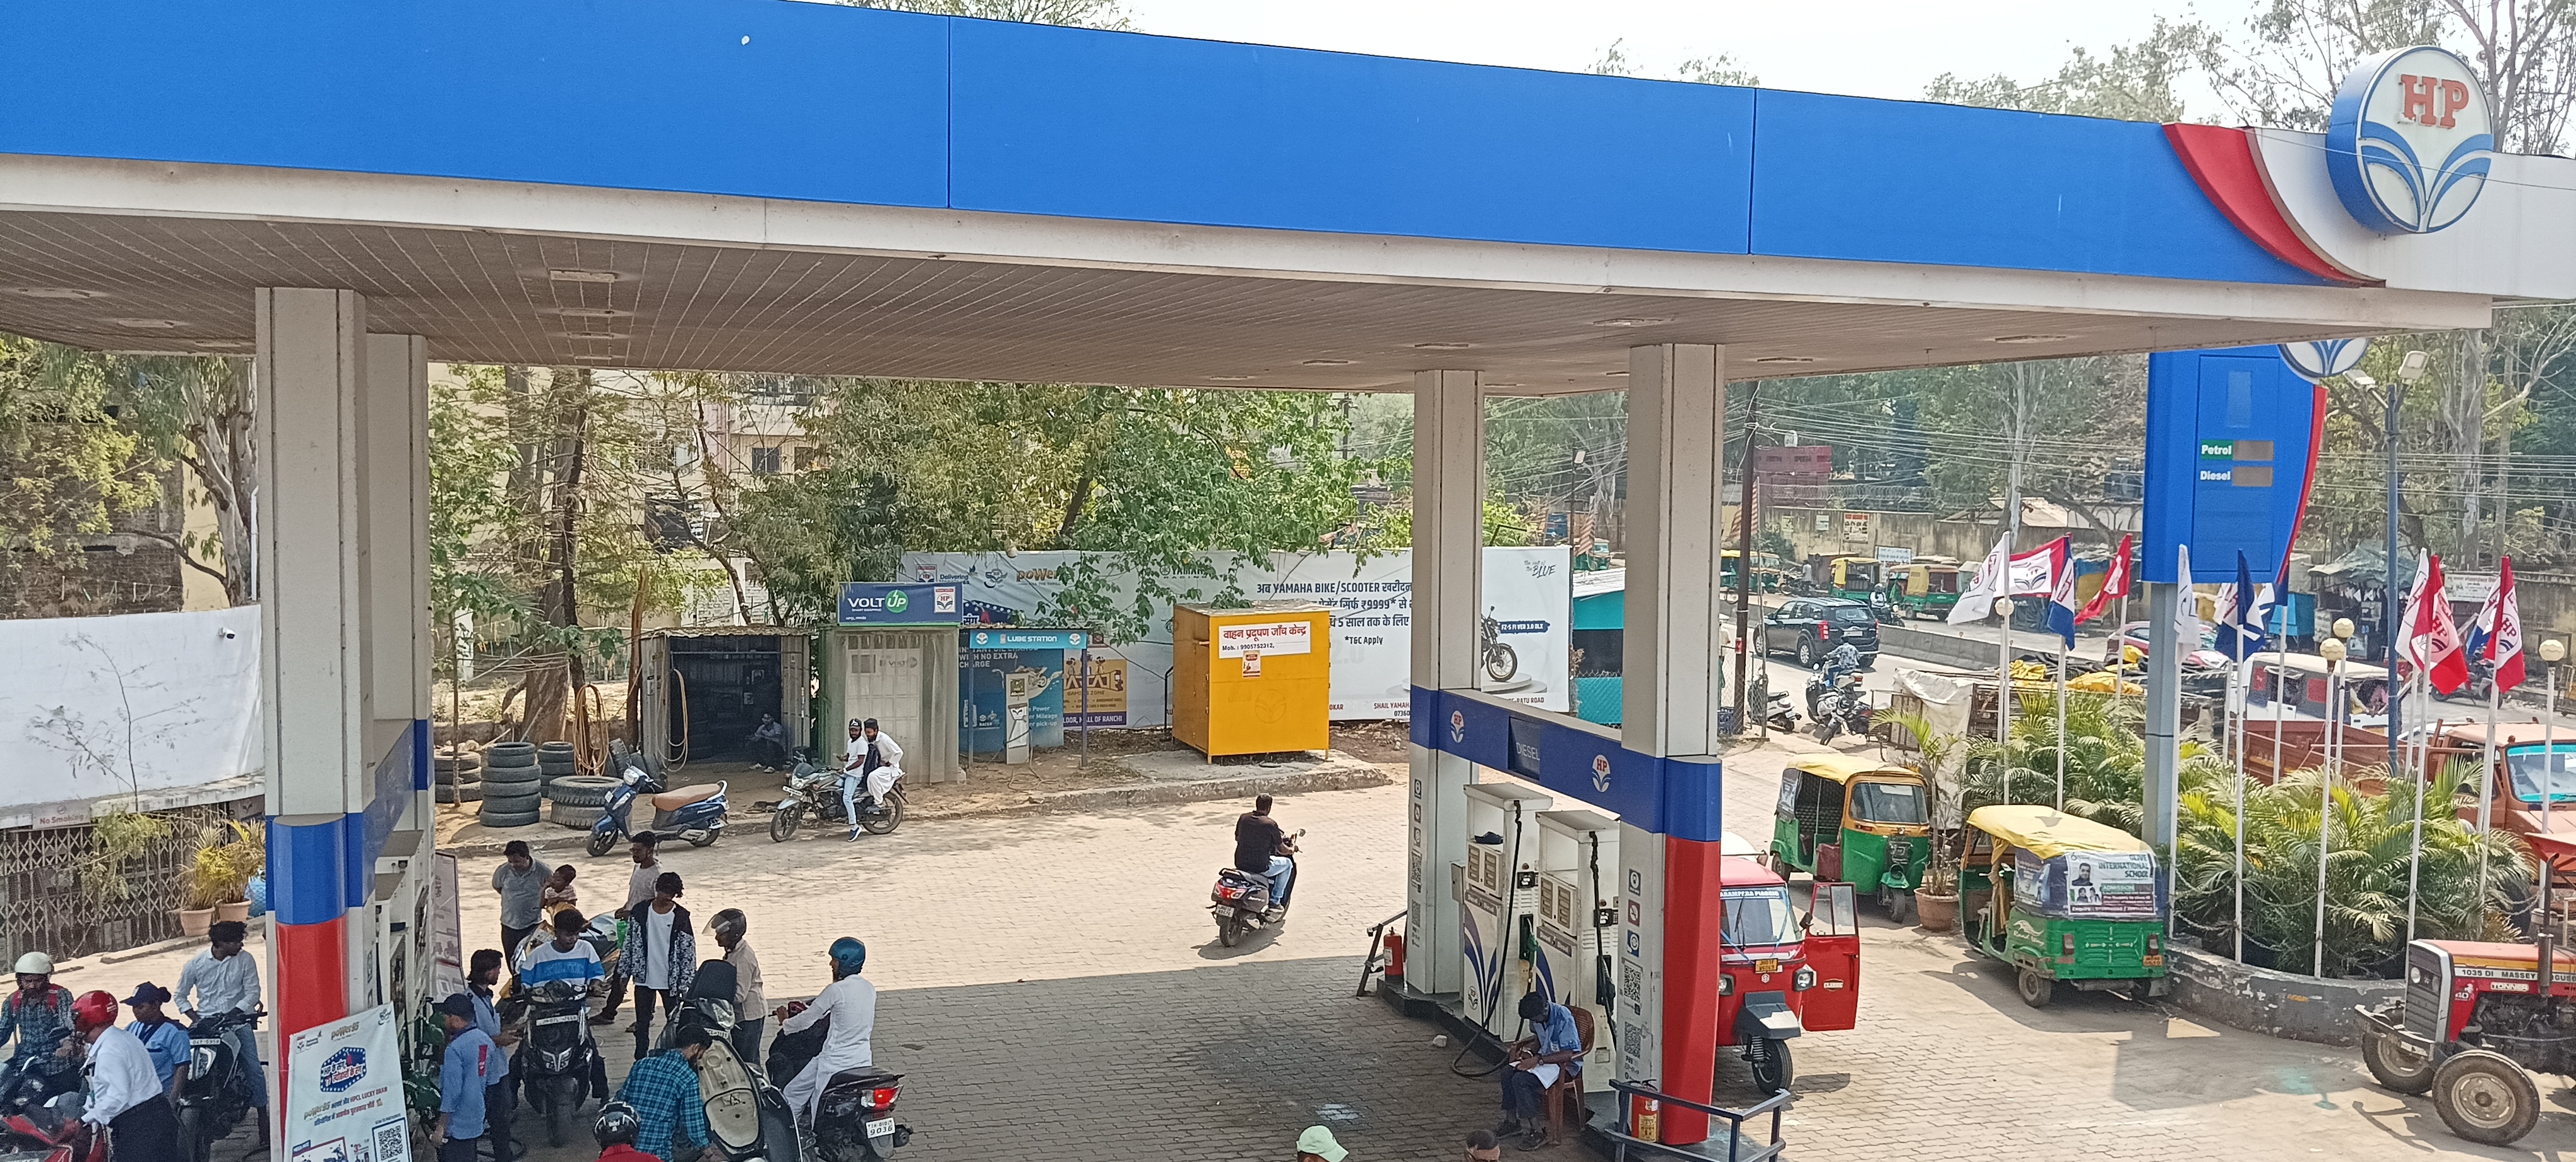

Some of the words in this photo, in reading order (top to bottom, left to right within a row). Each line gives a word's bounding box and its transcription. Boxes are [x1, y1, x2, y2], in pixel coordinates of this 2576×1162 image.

[2400, 74, 2470, 128] HP
[2201, 445, 2232, 455] Petrol
[2200, 470, 2231, 481] Diesel
[1532, 564, 1557, 578] BLUE
[1257, 583, 1271, 594] अब
[1273, 583, 1313, 594] YAMAHA
[1315, 580, 1380, 595] BIKE/SCOOTER
[847, 597, 885, 608] VOLT
[886, 590, 907, 608] UP
[1398, 596, 1407, 609] से
[1338, 618, 1344, 627] 5
[1345, 617, 1366, 627] साल
[1366, 617, 1381, 627] तक
[1381, 614, 1391, 626] के
[1392, 614, 1410, 626] लिए
[2432, 614, 2448, 637] HP
[2501, 617, 2517, 637] HP
[1223, 630, 1244, 640] वाहन
[1246, 628, 1269, 642] प्रदूषण
[1289, 623, 1307, 637] केन्द्र
[1364, 635, 1383, 645] Apply
[1063, 716, 1078, 724] LOOR,
[1453, 714, 1462, 726] HP
[1515, 741, 1541, 761] DIESEL
[1595, 758, 1607, 772] HP
[51, 814, 84, 824] Smoking
[2501, 971, 2536, 979] MASSEY
[362, 1090, 376, 1099] LUCKY
[870, 1125, 893, 1136] 9036
